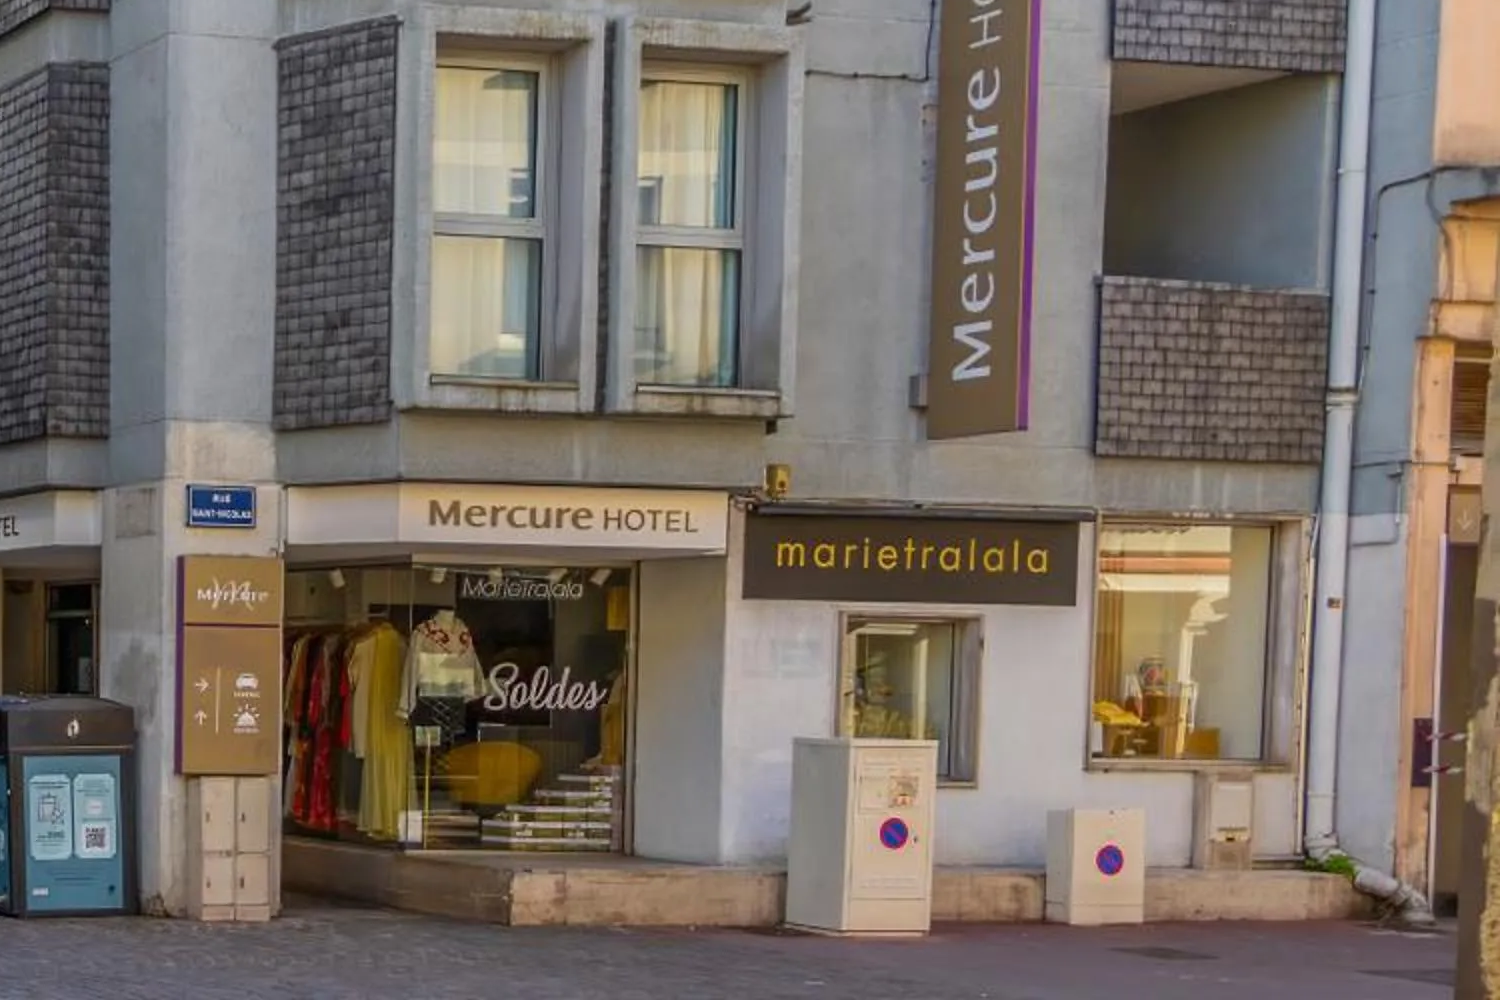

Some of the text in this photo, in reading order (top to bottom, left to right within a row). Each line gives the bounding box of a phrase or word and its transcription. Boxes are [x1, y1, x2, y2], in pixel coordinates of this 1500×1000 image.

[952, 67, 999, 382] Mercure
[428, 499, 699, 533] Mercure HOTEL
[775, 537, 1049, 573] marietralala
[483, 661, 607, 712] Soldes
